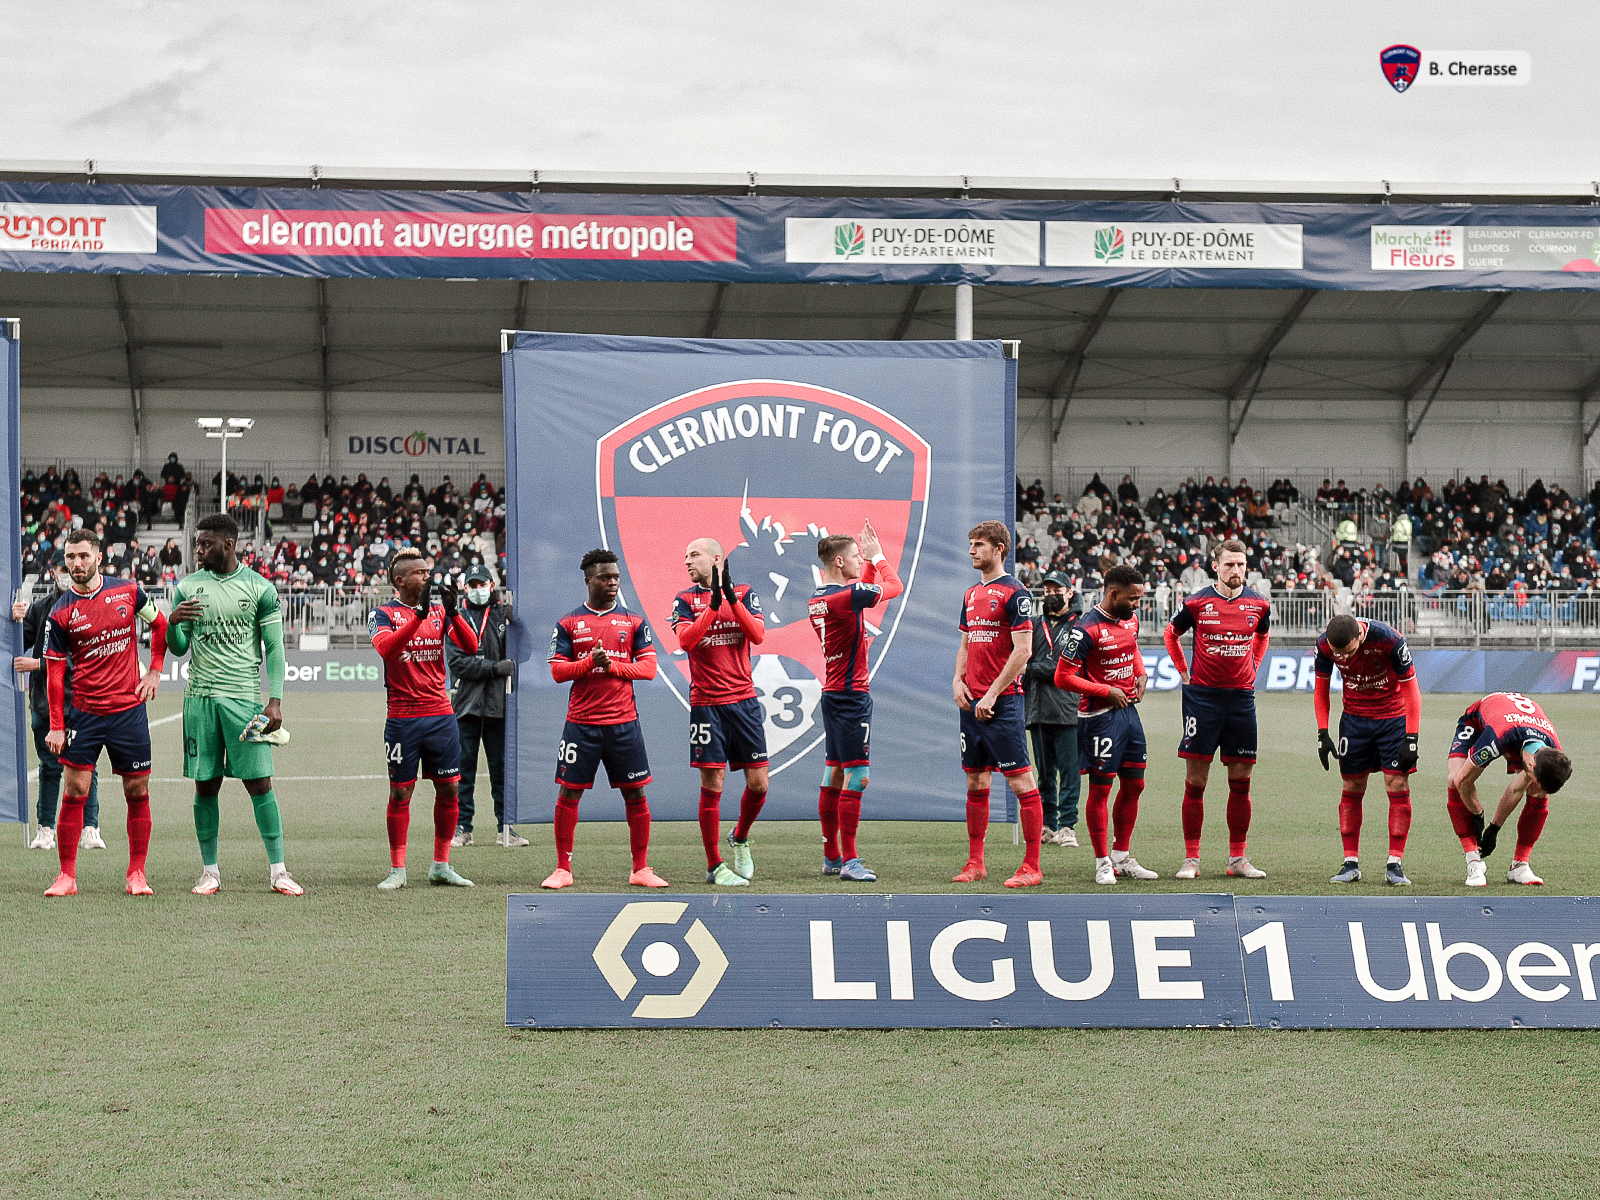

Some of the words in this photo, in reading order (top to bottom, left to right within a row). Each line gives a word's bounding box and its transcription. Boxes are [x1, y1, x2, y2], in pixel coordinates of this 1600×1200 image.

[242, 213, 385, 247] clermont
[393, 222, 534, 251] auvergne
[541, 220, 695, 258] métropole
[872, 224, 996, 245] PUY-DE-DÔME
[1131, 228, 1255, 248] PUY-DE-DÔME
[1375, 230, 1432, 246] Marché
[1468, 230, 1521, 239] BEAUMONT
[1528, 230, 1595, 240] CLERMONT-FD
[871, 245, 886, 257] LE
[893, 243, 996, 258] DÉPARTEMENT
[1131, 250, 1145, 260] LE
[1151, 247, 1255, 262] DÉPARTEMENT
[1390, 248, 1456, 268] Fleurs
[1408, 246, 1428, 254] aux
[1468, 243, 1510, 253] LEMPDES
[1528, 244, 1577, 254] COURNON
[349, 433, 486, 457] DISCONTAL
[628, 403, 806, 474] CLERMONT
[812, 410, 904, 475] FOOT
[284, 661, 322, 682] ber
[326, 661, 379, 682] Eats
[1572, 656, 1600, 691] F
[689, 723, 712, 745] 25
[860, 722, 870, 744] 7
[1458, 725, 1475, 740] 8
[1092, 736, 1113, 758] 12
[809, 919, 1205, 1001] LIGUE
[1240, 921, 1295, 1001] 1
[1347, 921, 1600, 1002] Uber
